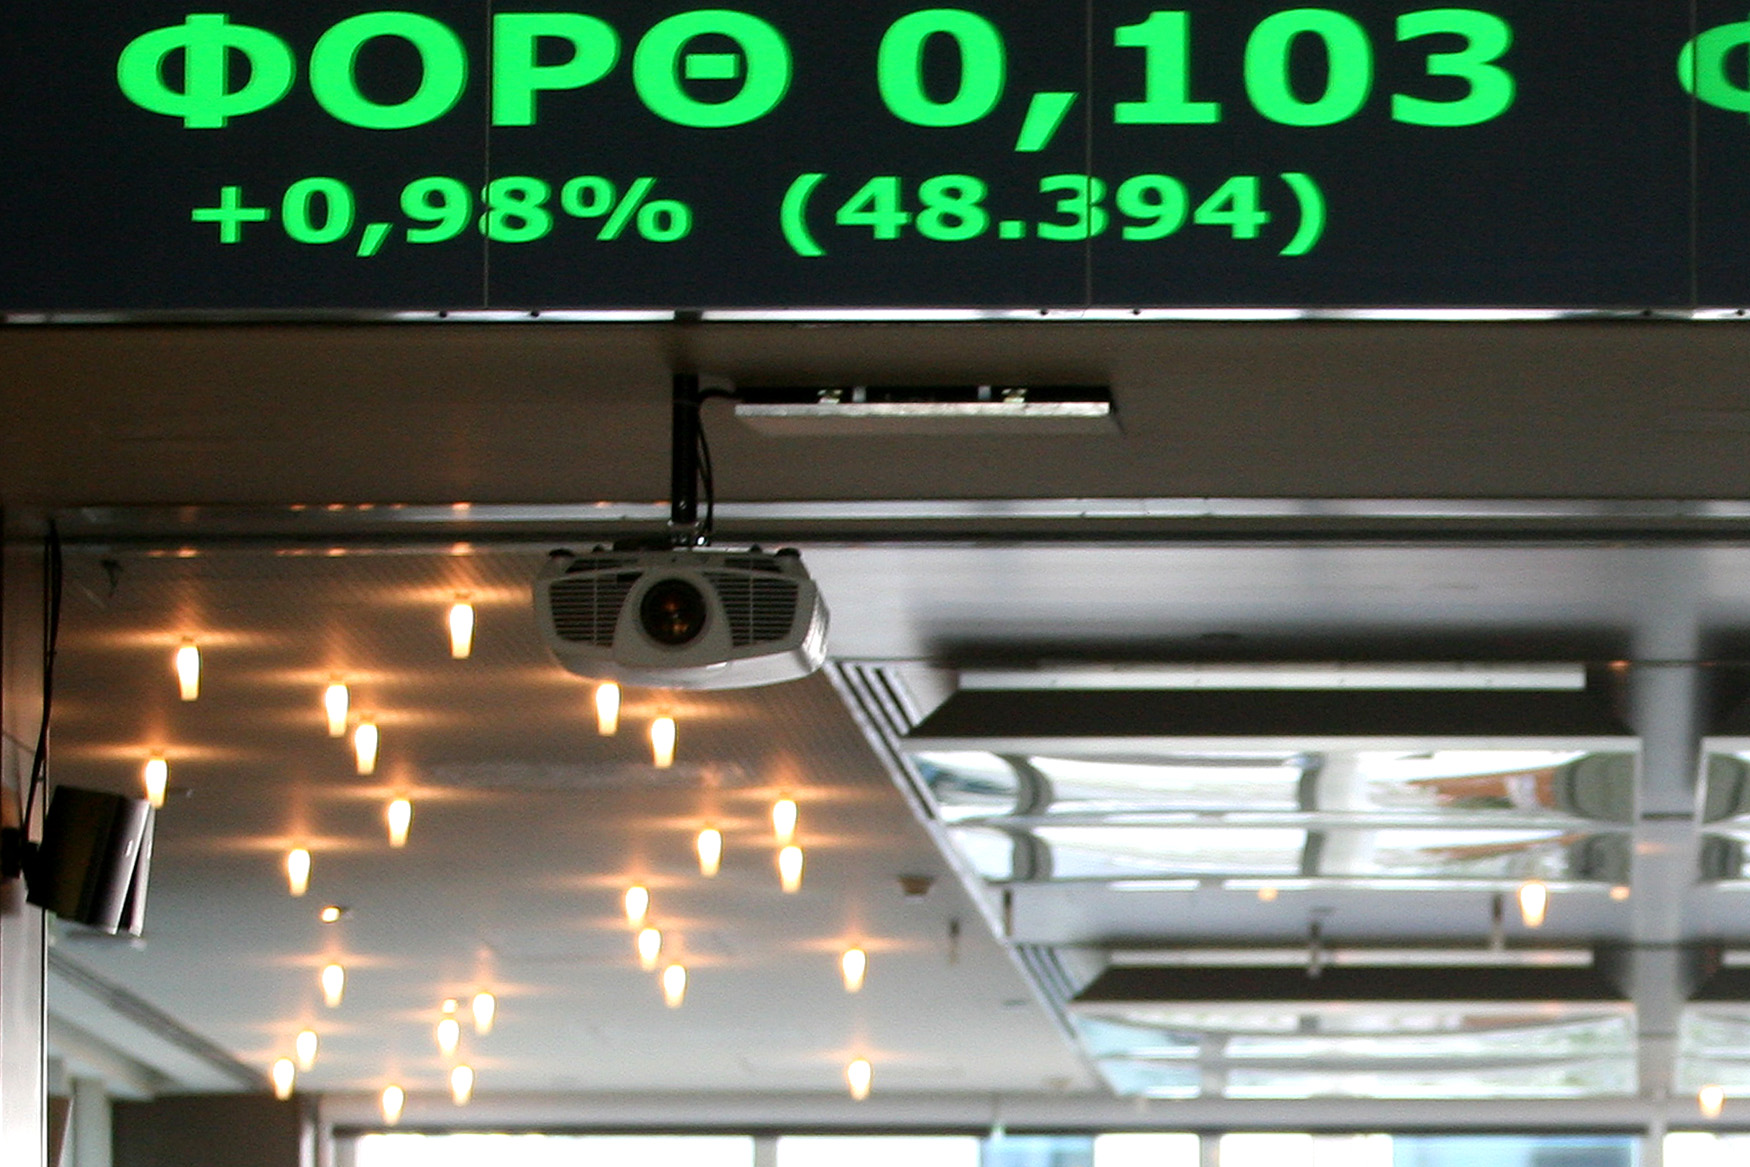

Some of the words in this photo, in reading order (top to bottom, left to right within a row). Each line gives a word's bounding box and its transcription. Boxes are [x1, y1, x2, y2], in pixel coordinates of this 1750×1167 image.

[116, 9, 792, 130] ΦΟΡΘ
[877, 7, 1516, 152] 0,103
[190, 174, 693, 257] +0,98%
[779, 171, 1326, 257] (48.394)
